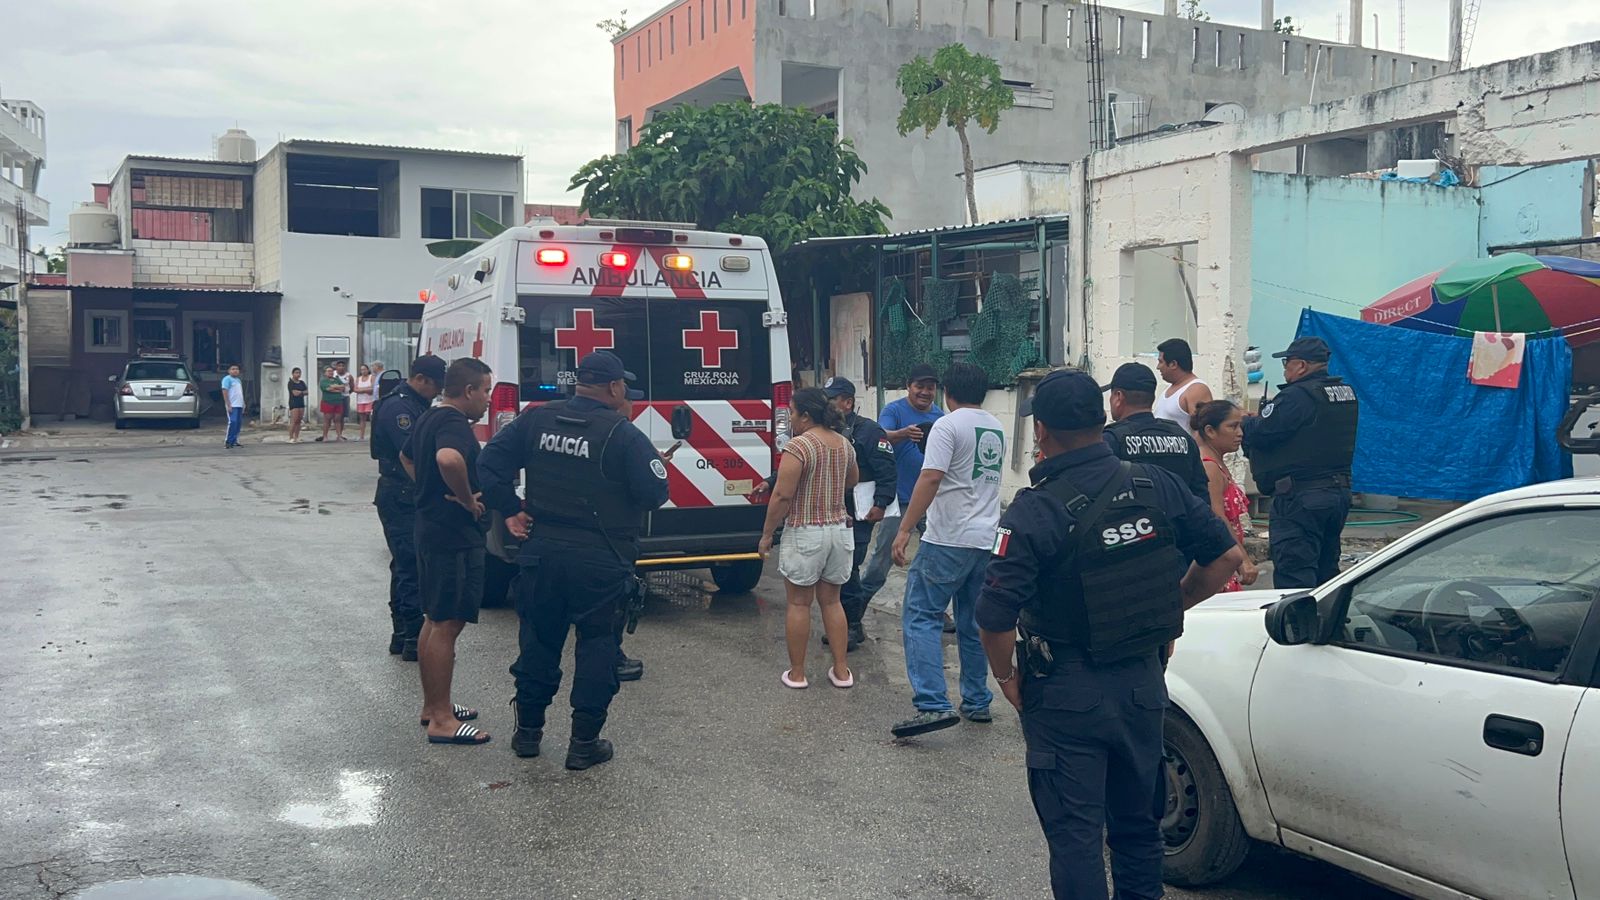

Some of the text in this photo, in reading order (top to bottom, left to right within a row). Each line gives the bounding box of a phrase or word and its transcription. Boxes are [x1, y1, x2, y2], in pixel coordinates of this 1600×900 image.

[572, 267, 722, 288] AMBULANCIA
[1374, 296, 1421, 322] DIRECT
[439, 329, 464, 351] AMBULANCIA
[539, 433, 589, 458] POLICÍA
[1126, 436, 1188, 454] SSP SOLIDARIDAD
[723, 459, 744, 469] 305
[1102, 517, 1153, 545] SSC
